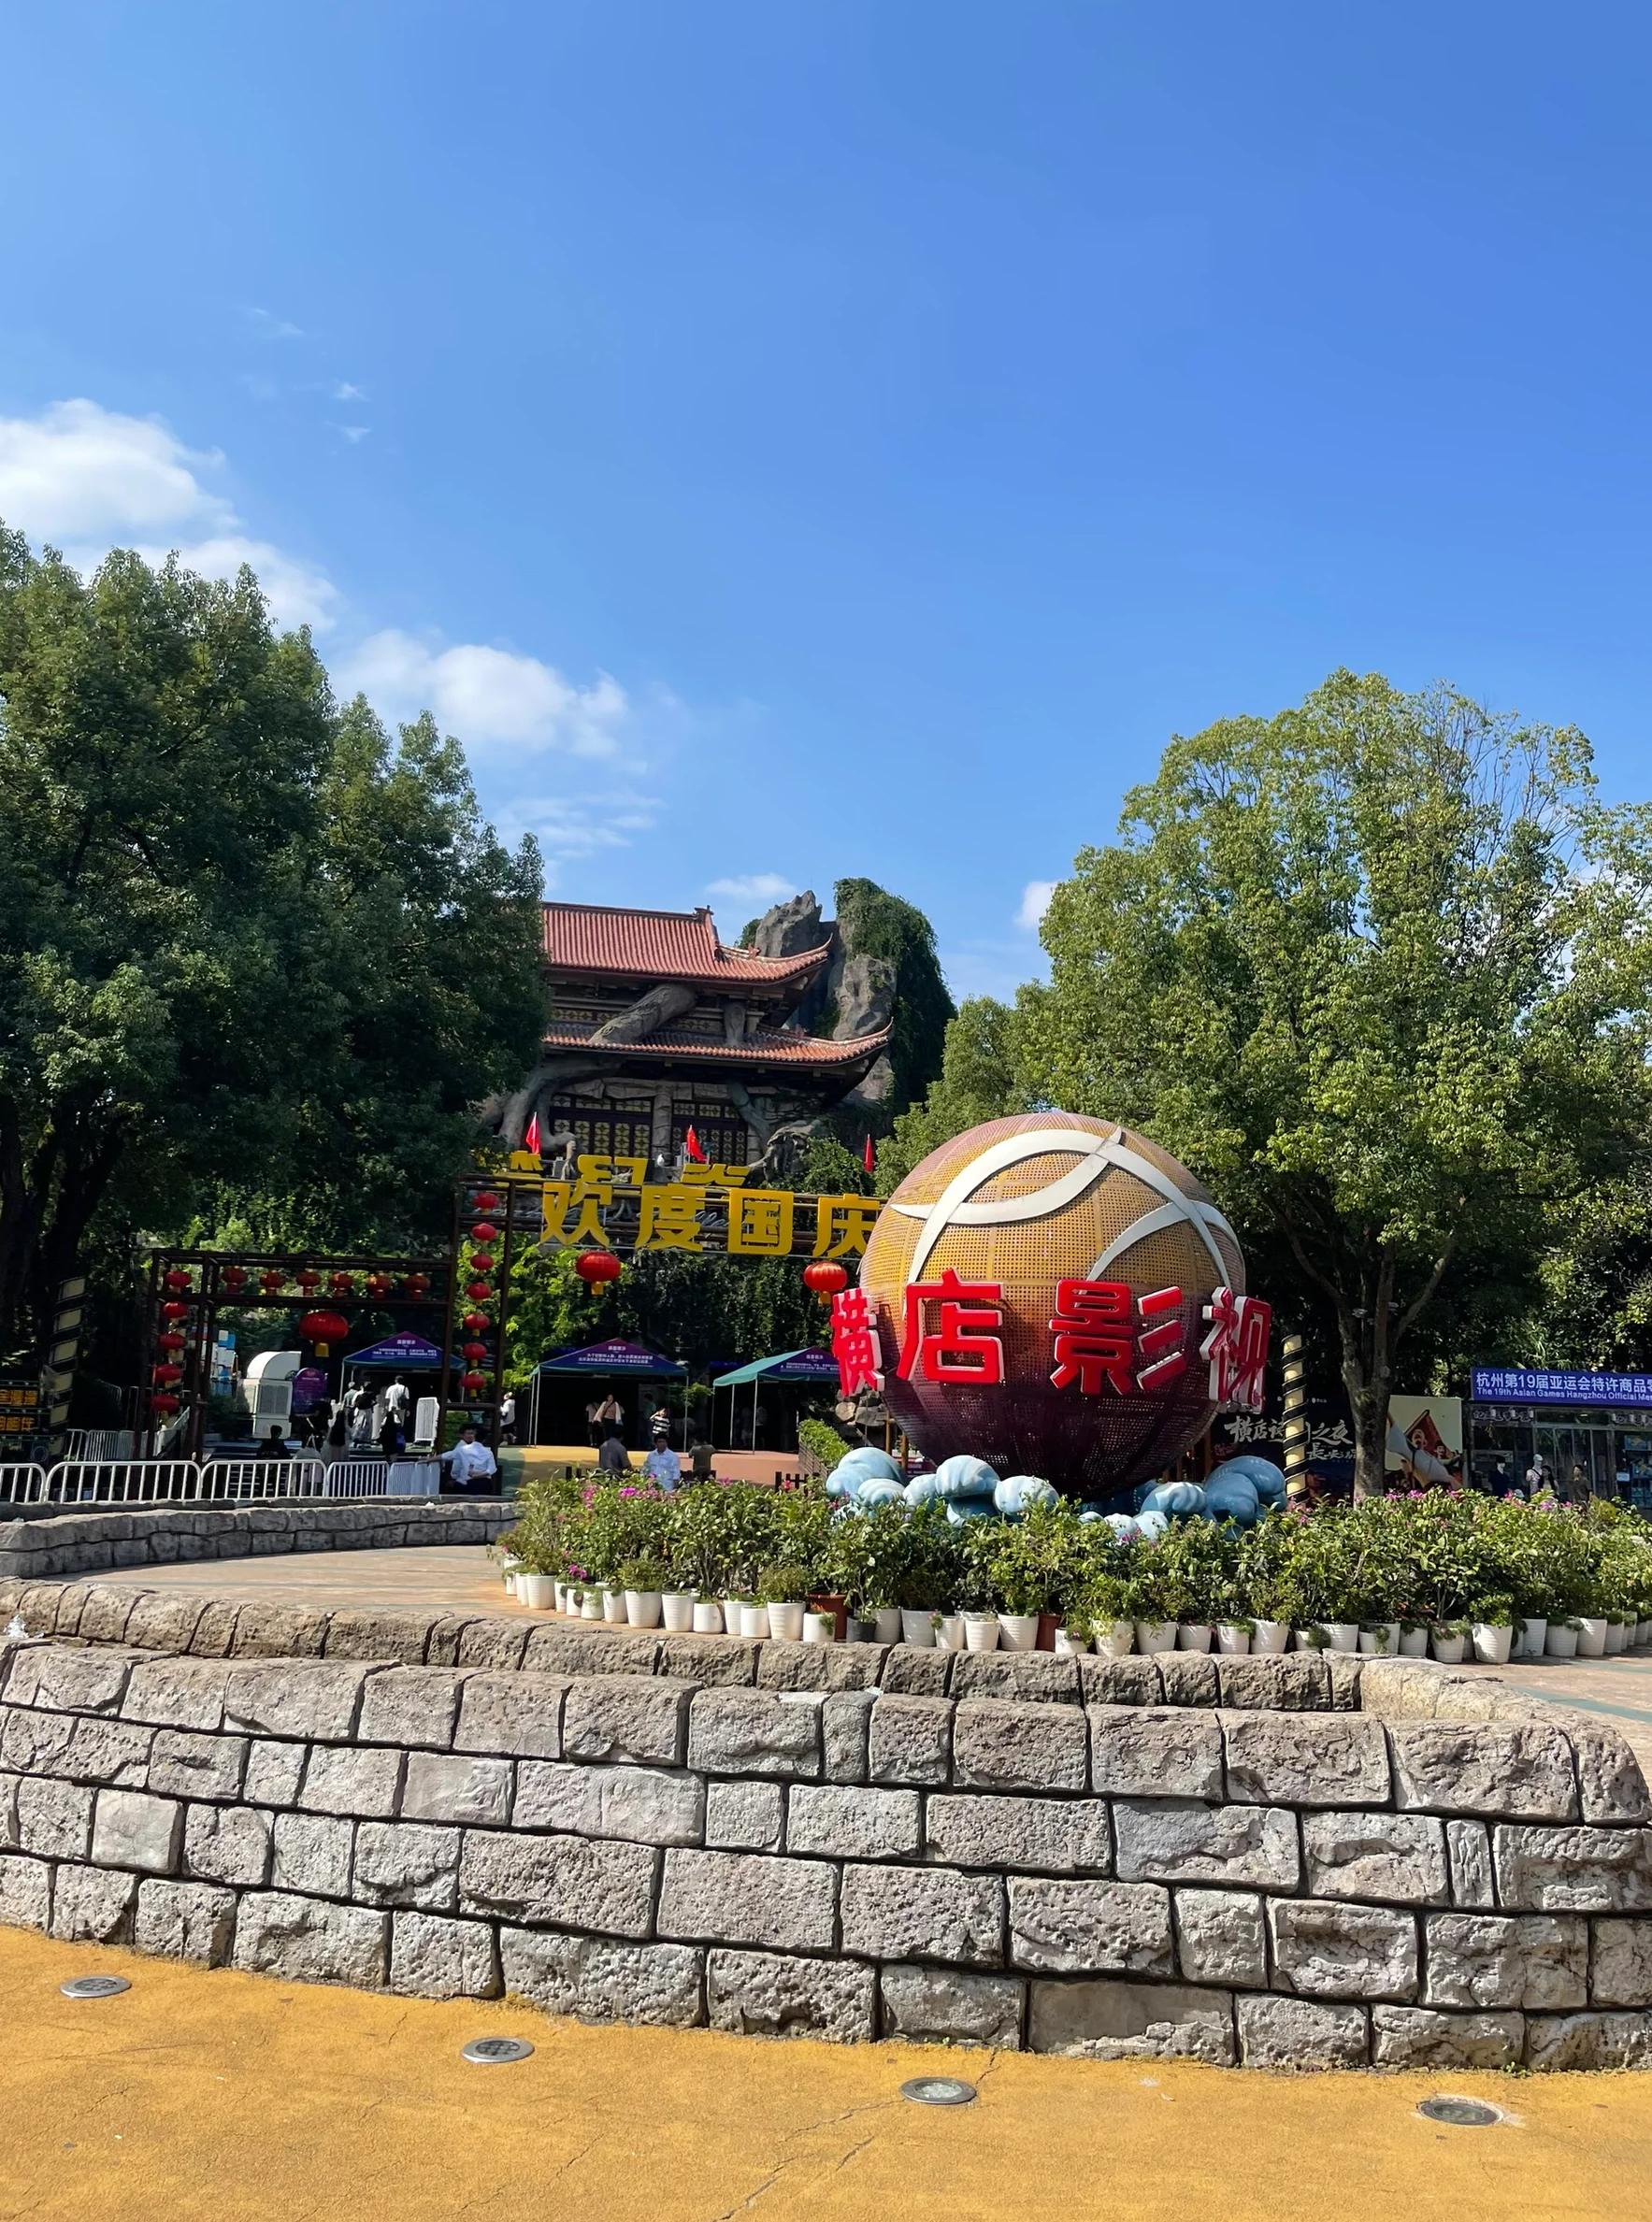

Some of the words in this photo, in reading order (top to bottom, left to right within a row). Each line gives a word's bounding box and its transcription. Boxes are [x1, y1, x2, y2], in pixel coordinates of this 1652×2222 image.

[539, 1182, 879, 1259] 欢度国庆
[831, 1268, 1272, 1414] 横店影视
[1476, 1386, 1493, 1396] The
[1495, 1387, 1512, 1397] 19th
[1513, 1388, 1536, 1398] Asian
[1537, 1389, 1565, 1398] Games
[1567, 1390, 1607, 1401] Hangzhou
[1608, 1391, 1637, 1400] Official
